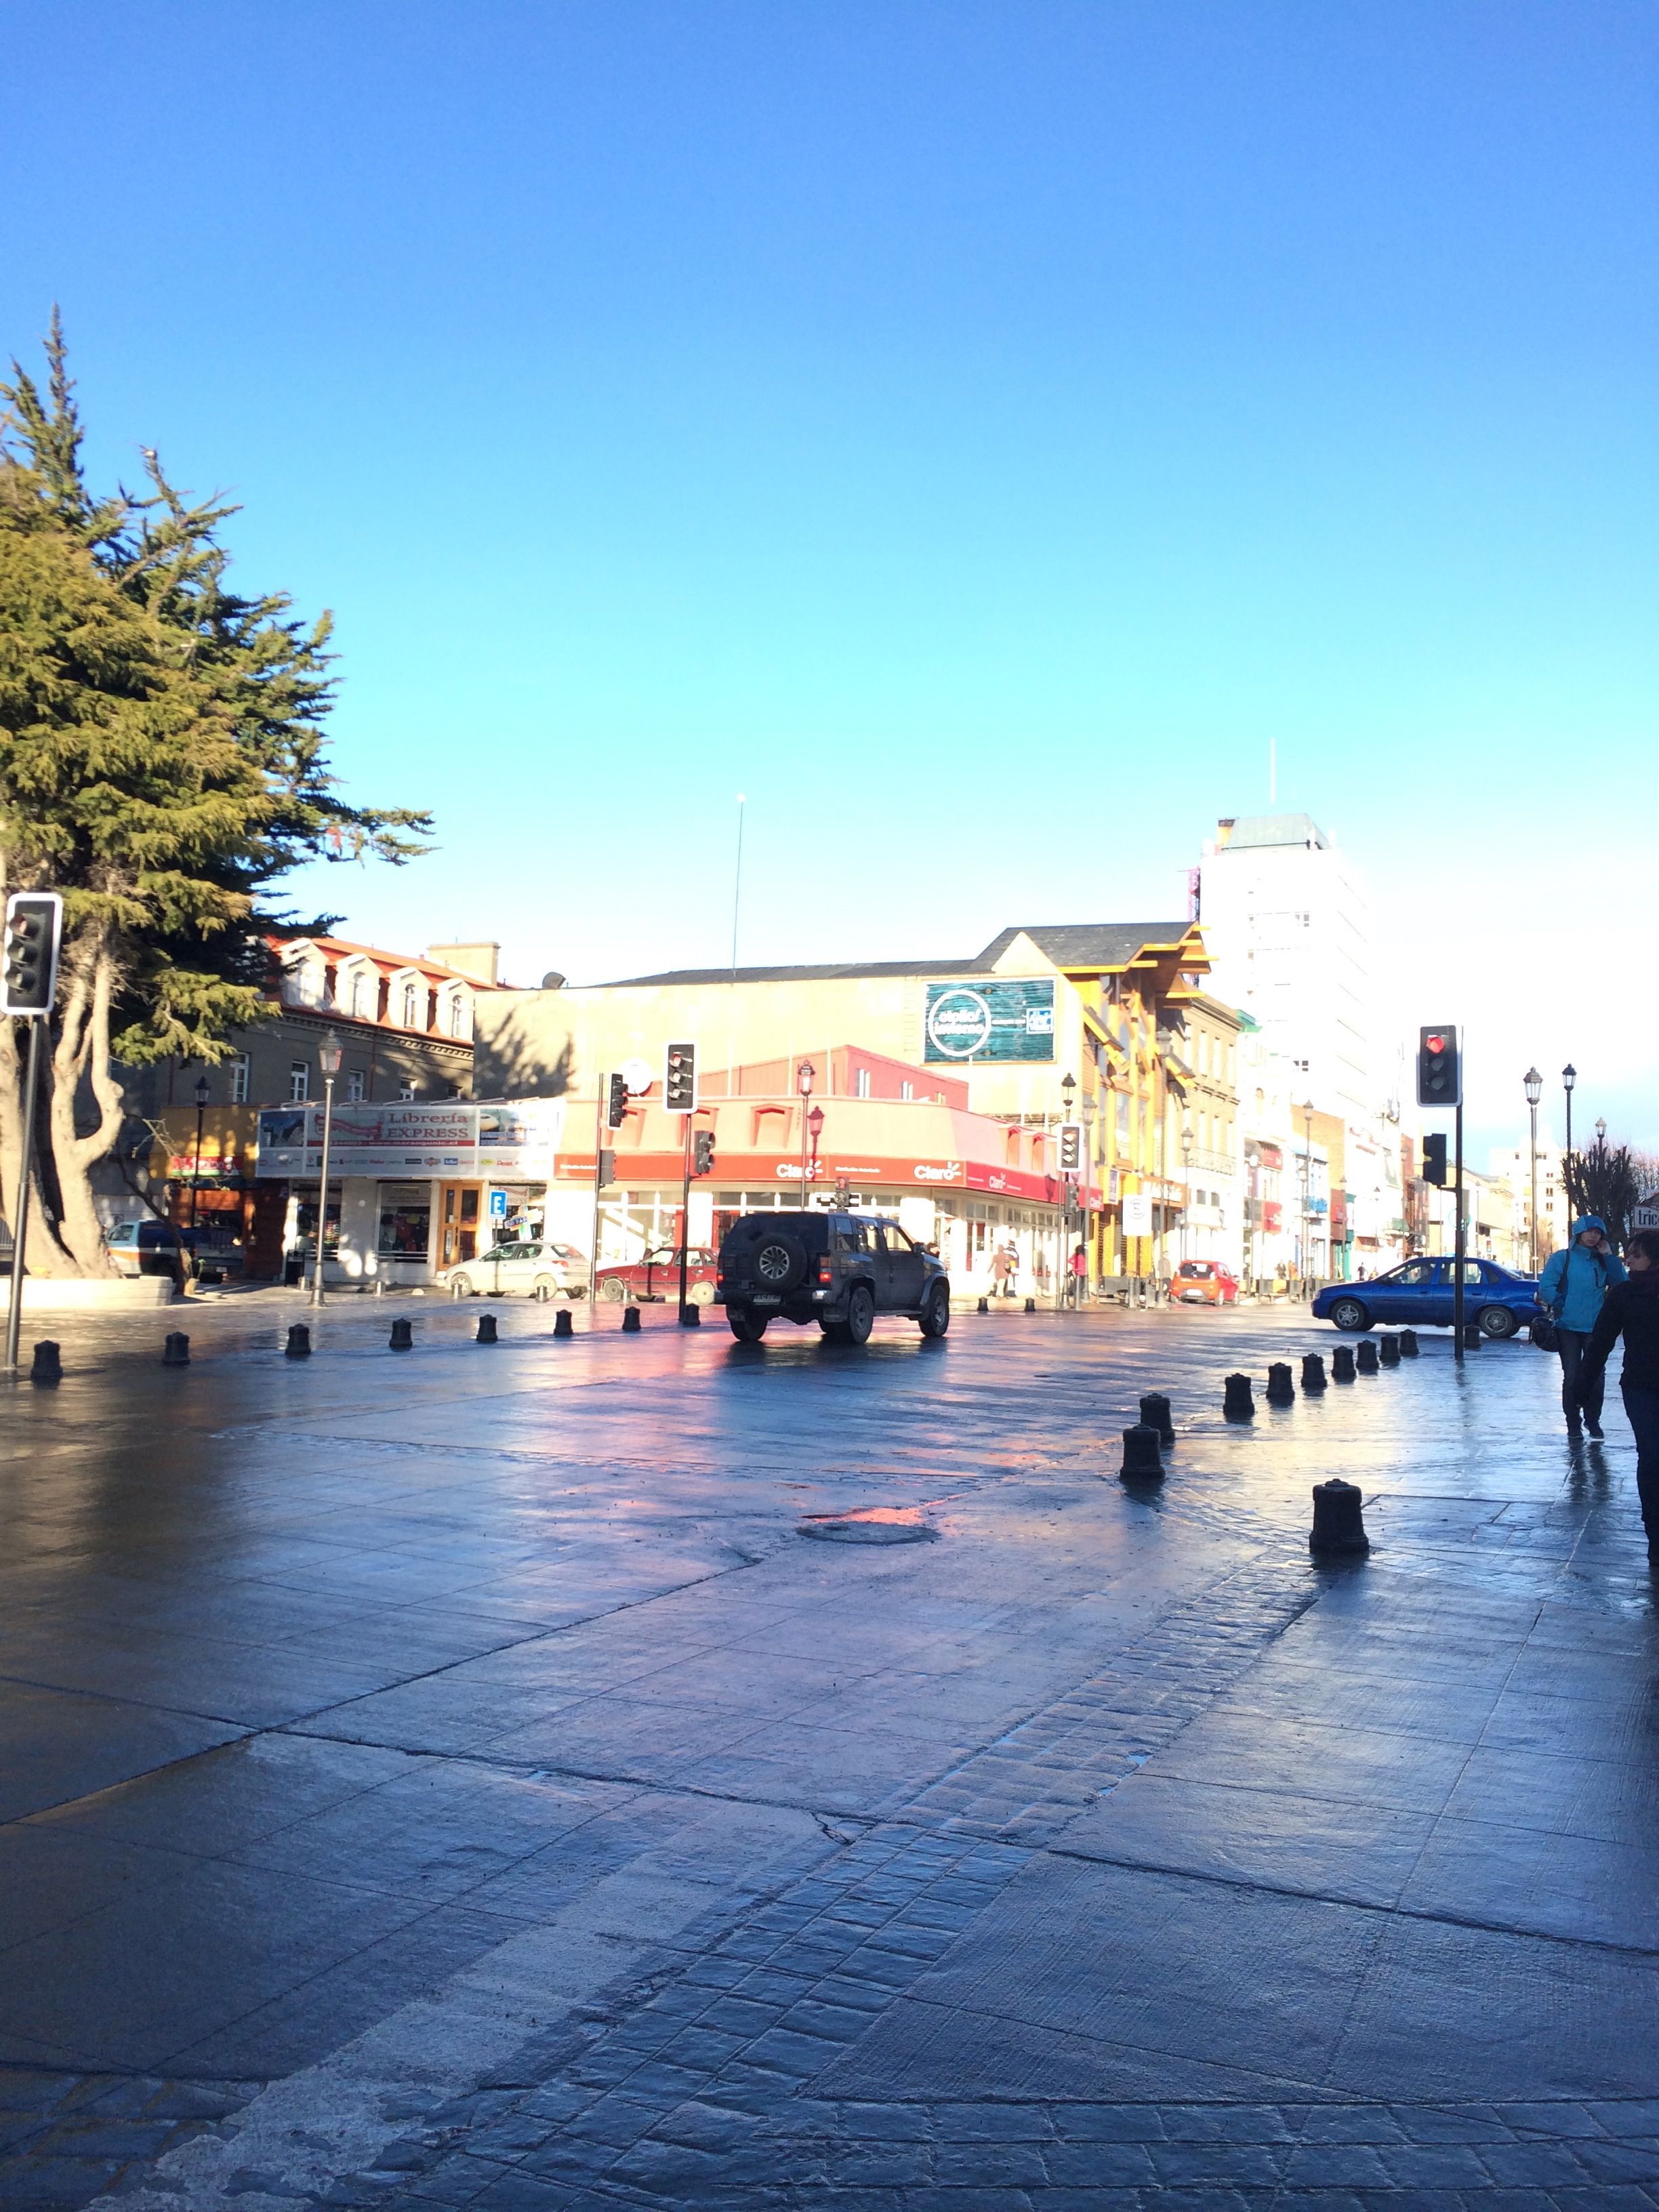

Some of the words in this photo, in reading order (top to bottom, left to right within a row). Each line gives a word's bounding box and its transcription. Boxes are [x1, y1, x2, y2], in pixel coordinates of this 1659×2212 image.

[388, 1112, 468, 1124] Librería
[388, 1127, 468, 1138] EXPRESS
[914, 1164, 957, 1181] Claro
[494, 1195, 501, 1214] E
[1638, 1209, 1659, 1225] tric
